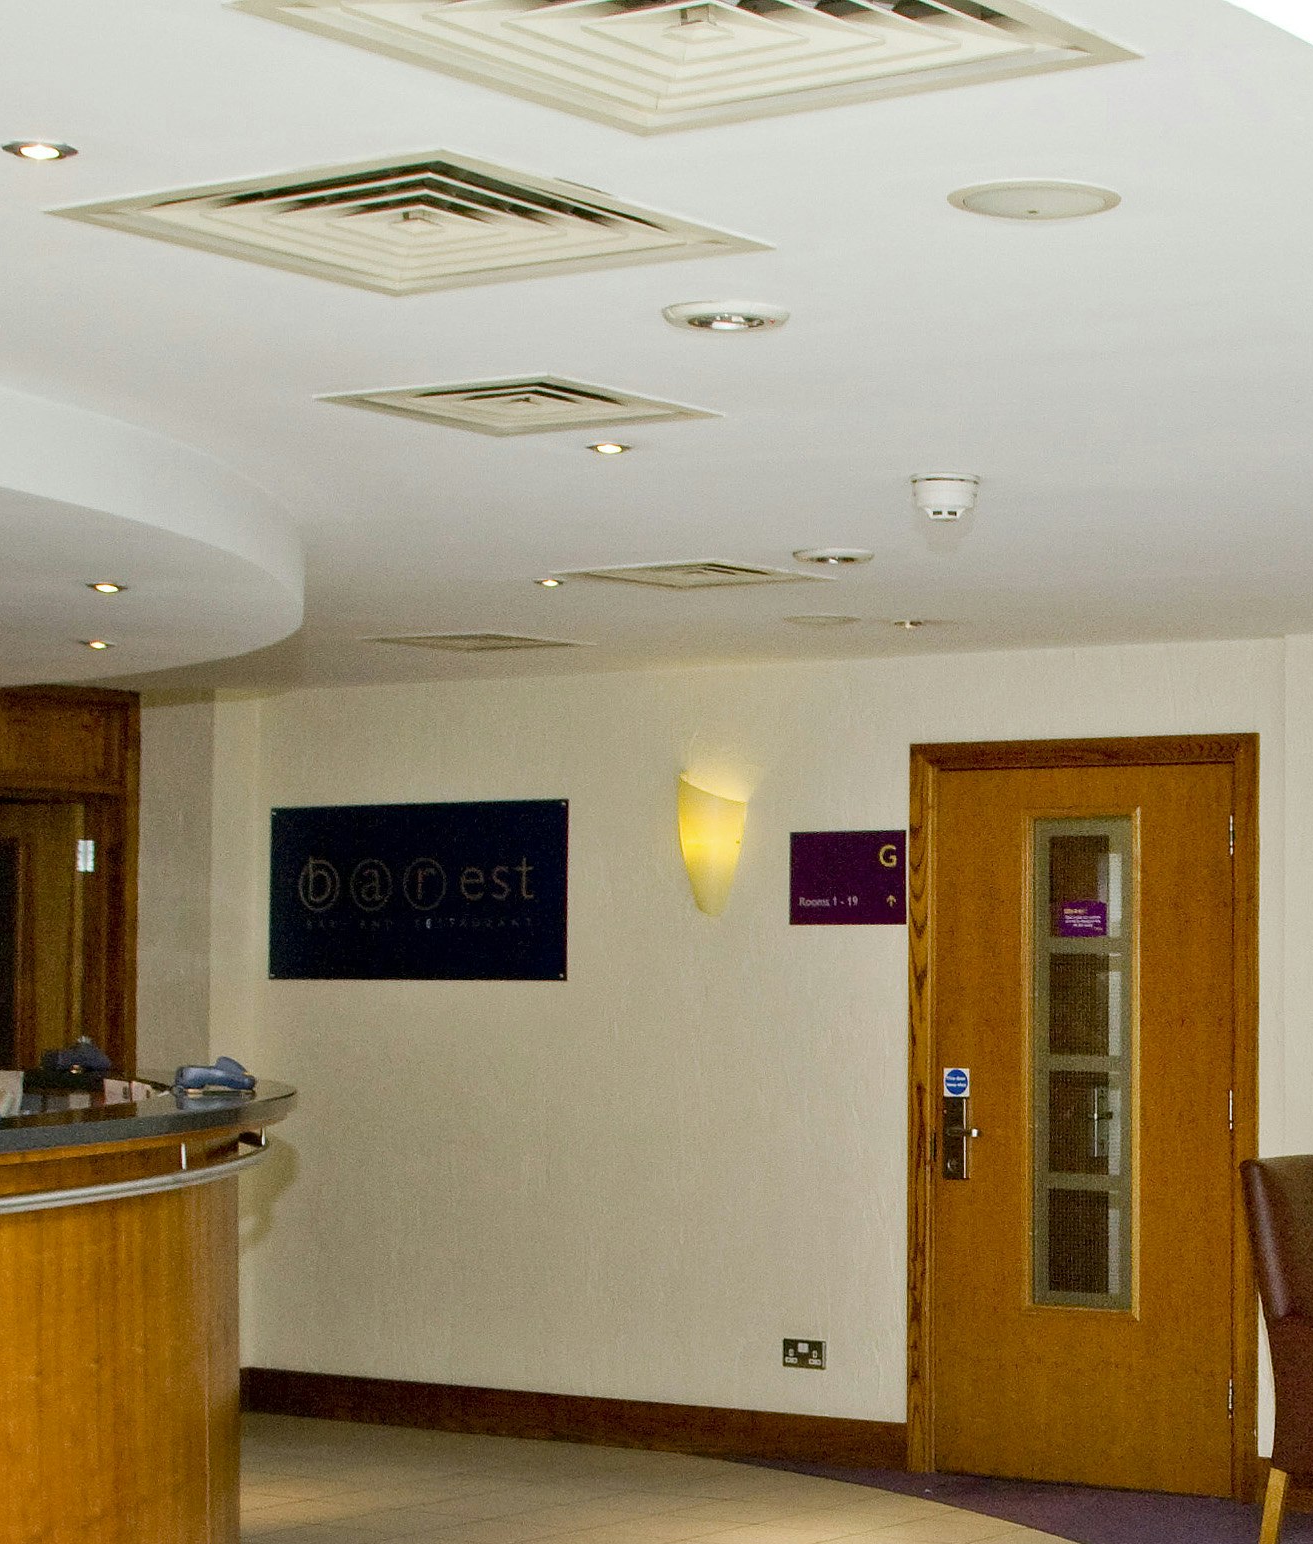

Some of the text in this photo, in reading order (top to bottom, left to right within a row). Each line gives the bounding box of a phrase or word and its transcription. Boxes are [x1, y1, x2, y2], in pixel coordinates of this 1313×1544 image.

[879, 844, 898, 868] G
[798, 896, 830, 907] Rooms
[832, 895, 838, 906] 1
[847, 895, 858, 907] 19
